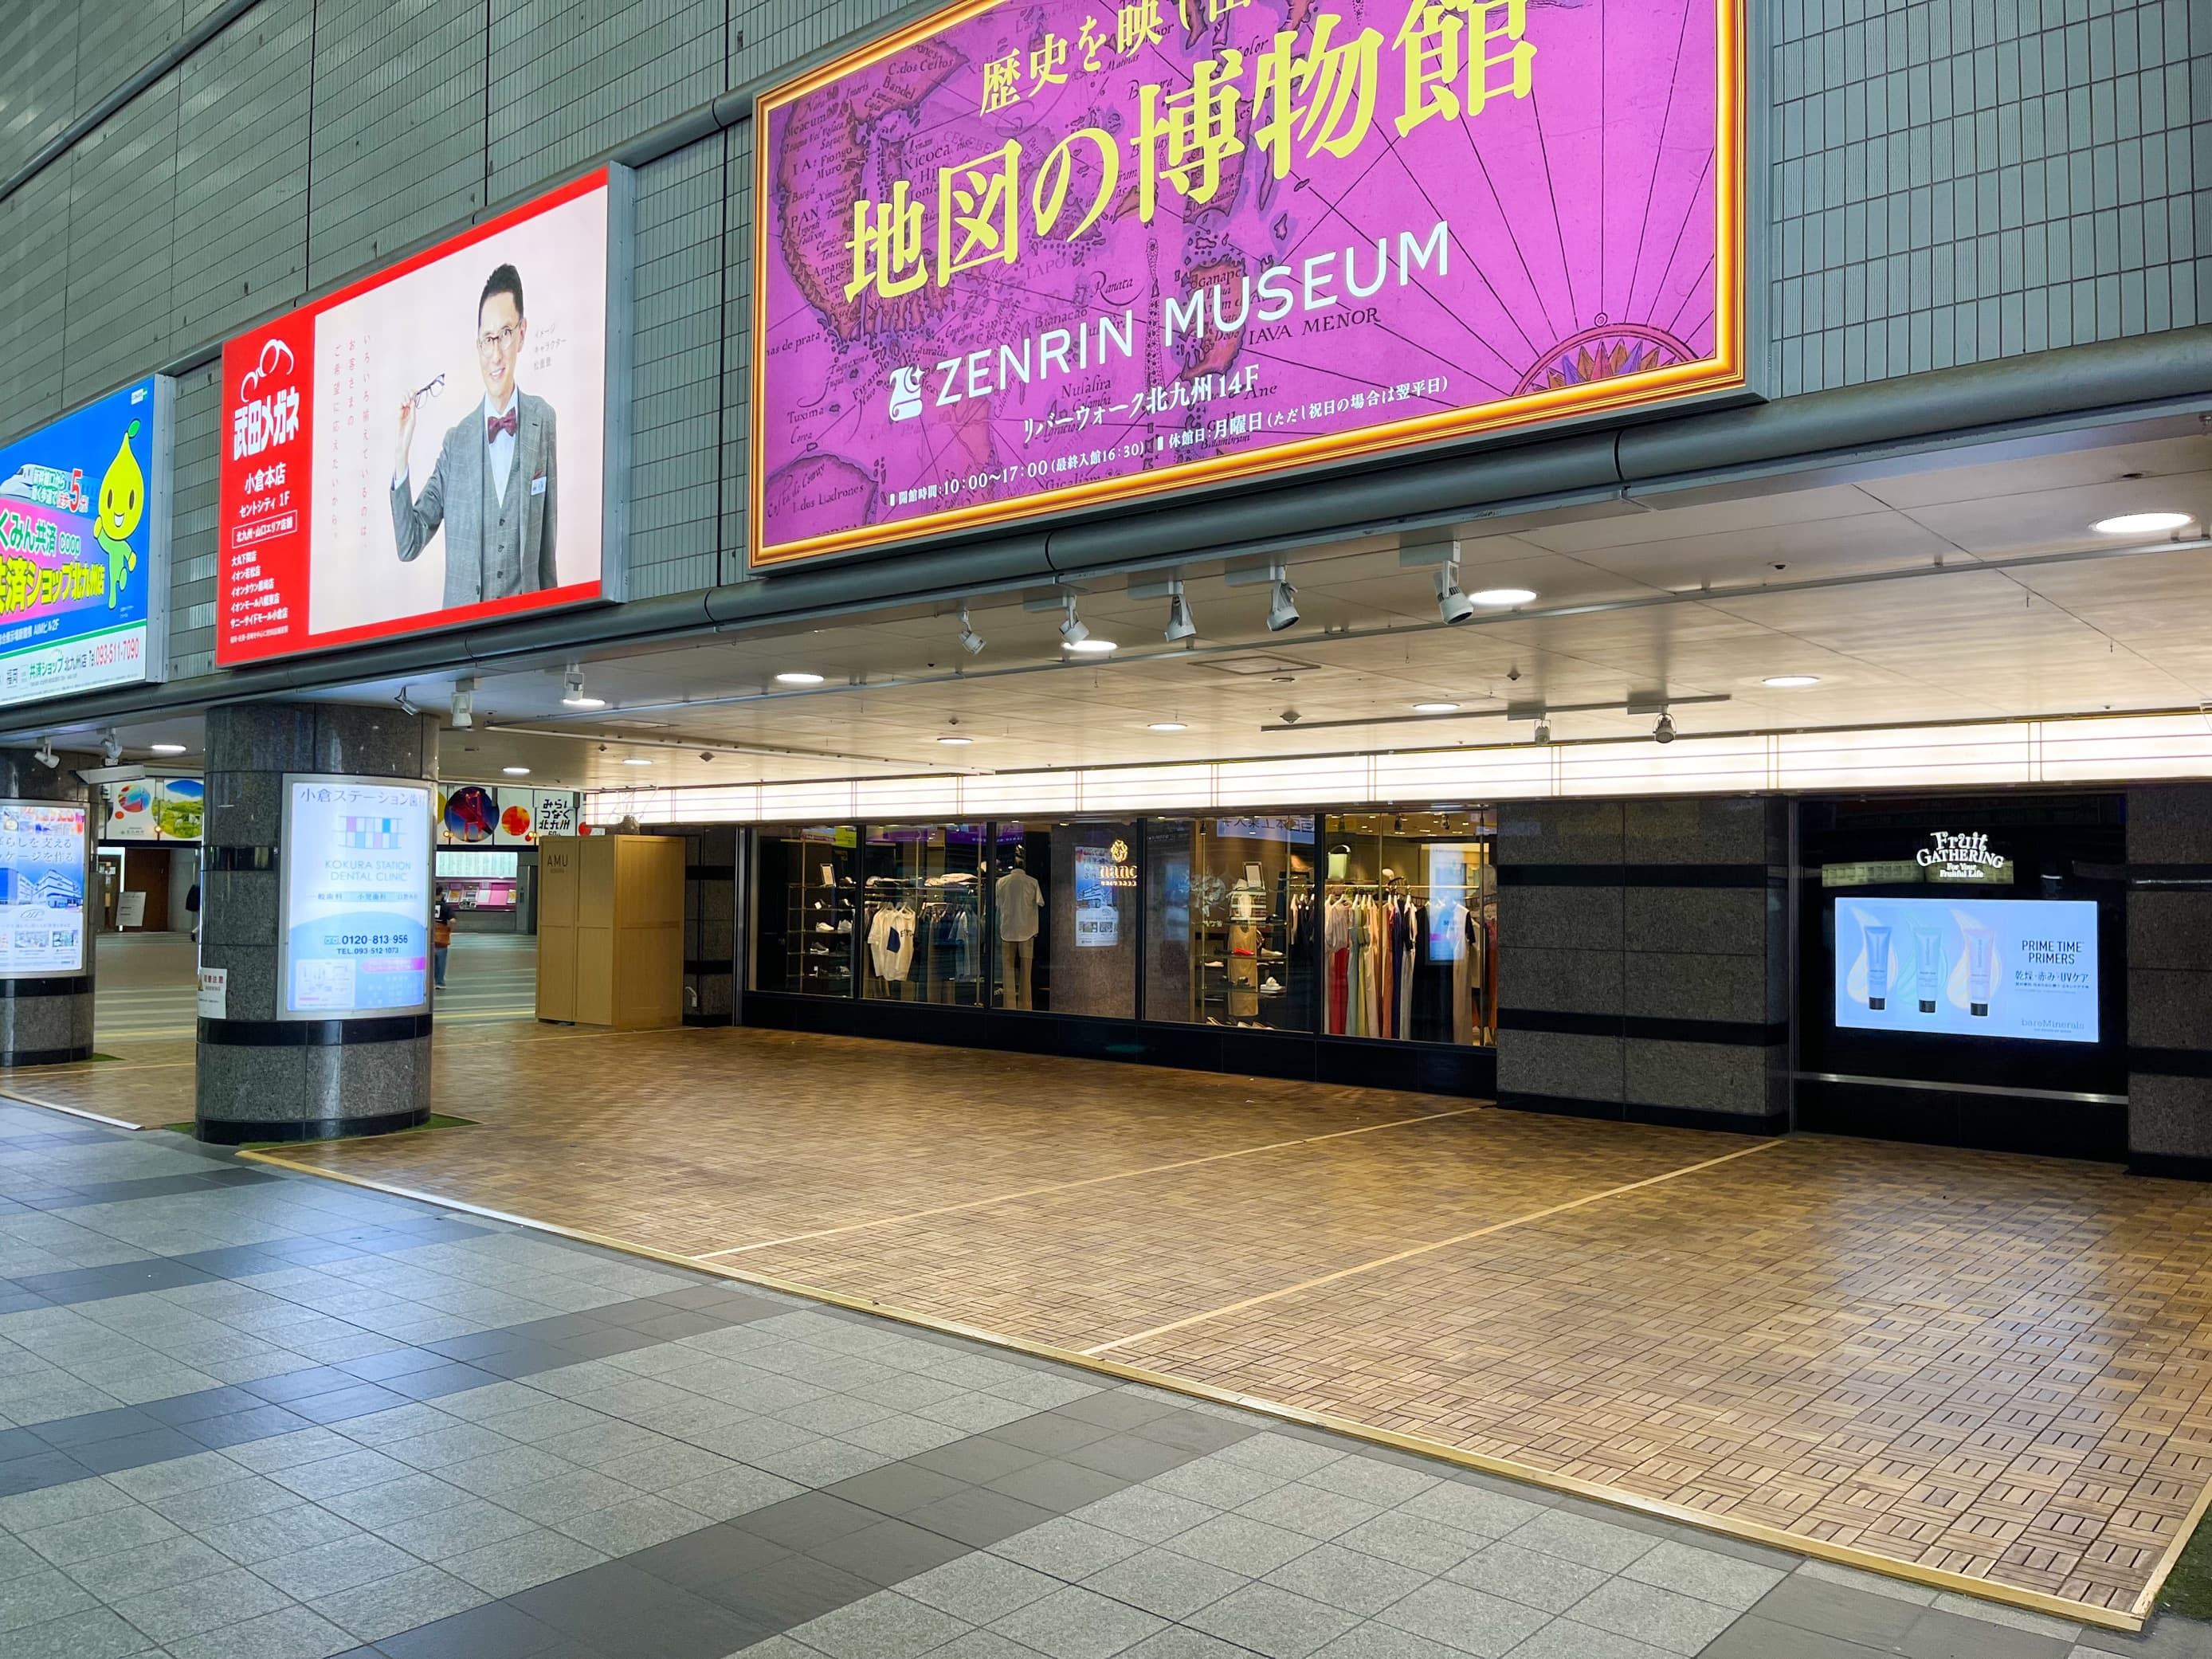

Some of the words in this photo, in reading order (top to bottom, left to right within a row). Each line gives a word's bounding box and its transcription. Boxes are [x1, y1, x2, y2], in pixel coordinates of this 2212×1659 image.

[844, 0, 1538, 304] 地図の博物館
[935, 310, 1133, 408] ZENRIN
[1165, 220, 1449, 347] MUSEUM
[1249, 324, 1293, 345] IAVA
[1302, 307, 1382, 335] MENOR
[1024, 374, 1212, 444] リバーウォーク北九州
[1218, 363, 1261, 398] 14F
[233, 386, 300, 461] 武田メガネ
[245, 461, 287, 494] 小倉本店
[239, 496, 276, 519] セントシティ
[279, 490, 291, 507] 1F
[0, 837, 72, 849] らしを支える
[1930, 831, 1989, 851] Fruit
[324, 859, 372, 870] KOKURA
[376, 861, 411, 870] STATION
[547, 854, 568, 867] AMU
[1916, 848, 2005, 869] GATHERING
[331, 872, 372, 881] DENTAL
[376, 872, 407, 881] CLINIC
[342, 934, 408, 945] 0120-813-956
[2022, 939, 2054, 952] PRIME
[2029, 952, 2076, 965] PRIMERS
